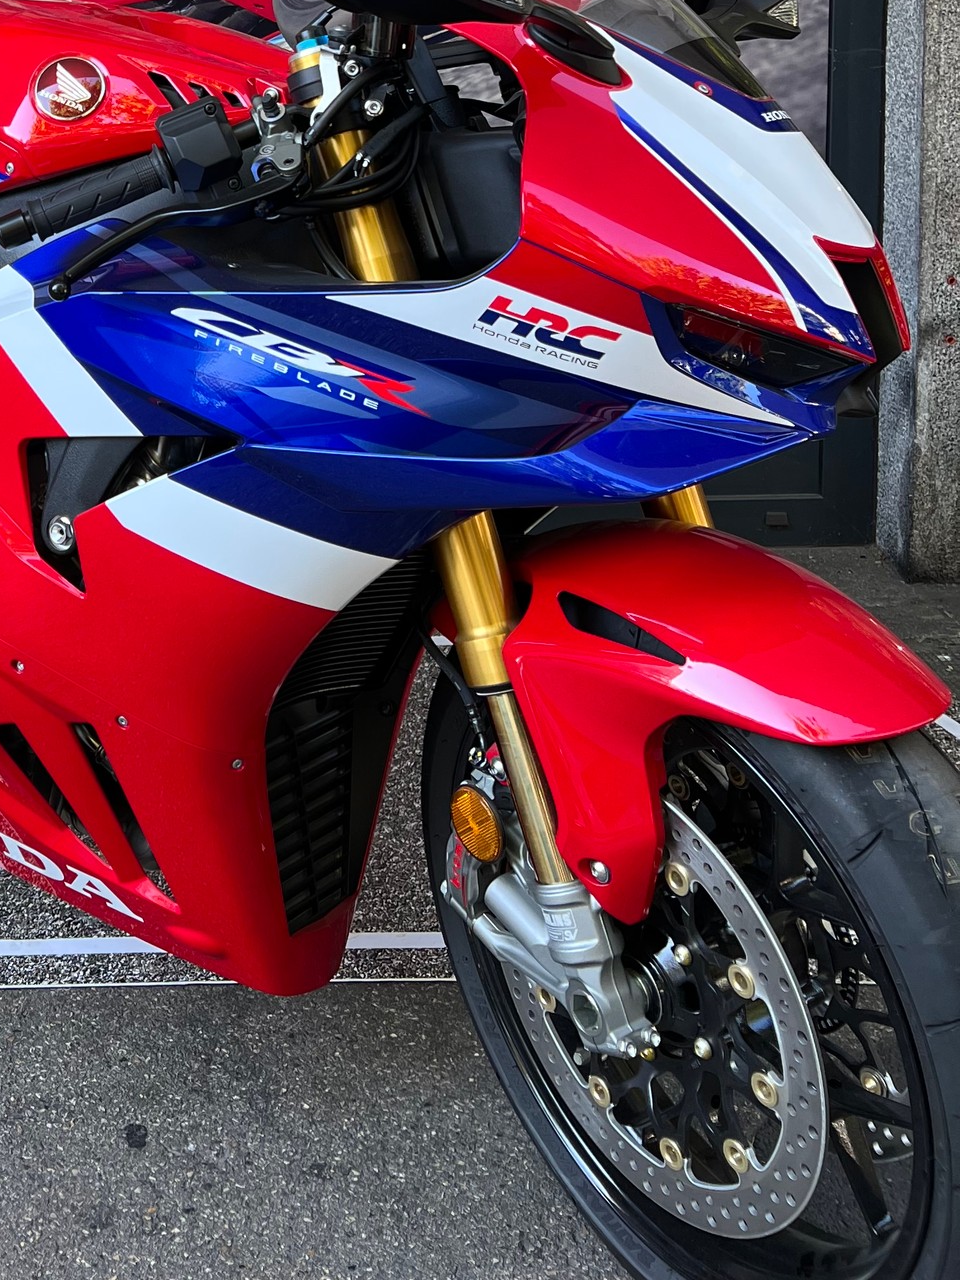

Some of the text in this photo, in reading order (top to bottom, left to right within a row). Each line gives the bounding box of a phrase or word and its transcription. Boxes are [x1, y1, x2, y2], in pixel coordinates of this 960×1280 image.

[40, 89, 84, 113] HONDA
[761, 110, 791, 122] HON
[473, 323, 599, 369] Honda RACING
[478, 295, 622, 360] HRC
[195, 329, 379, 410] FIREBLADE
